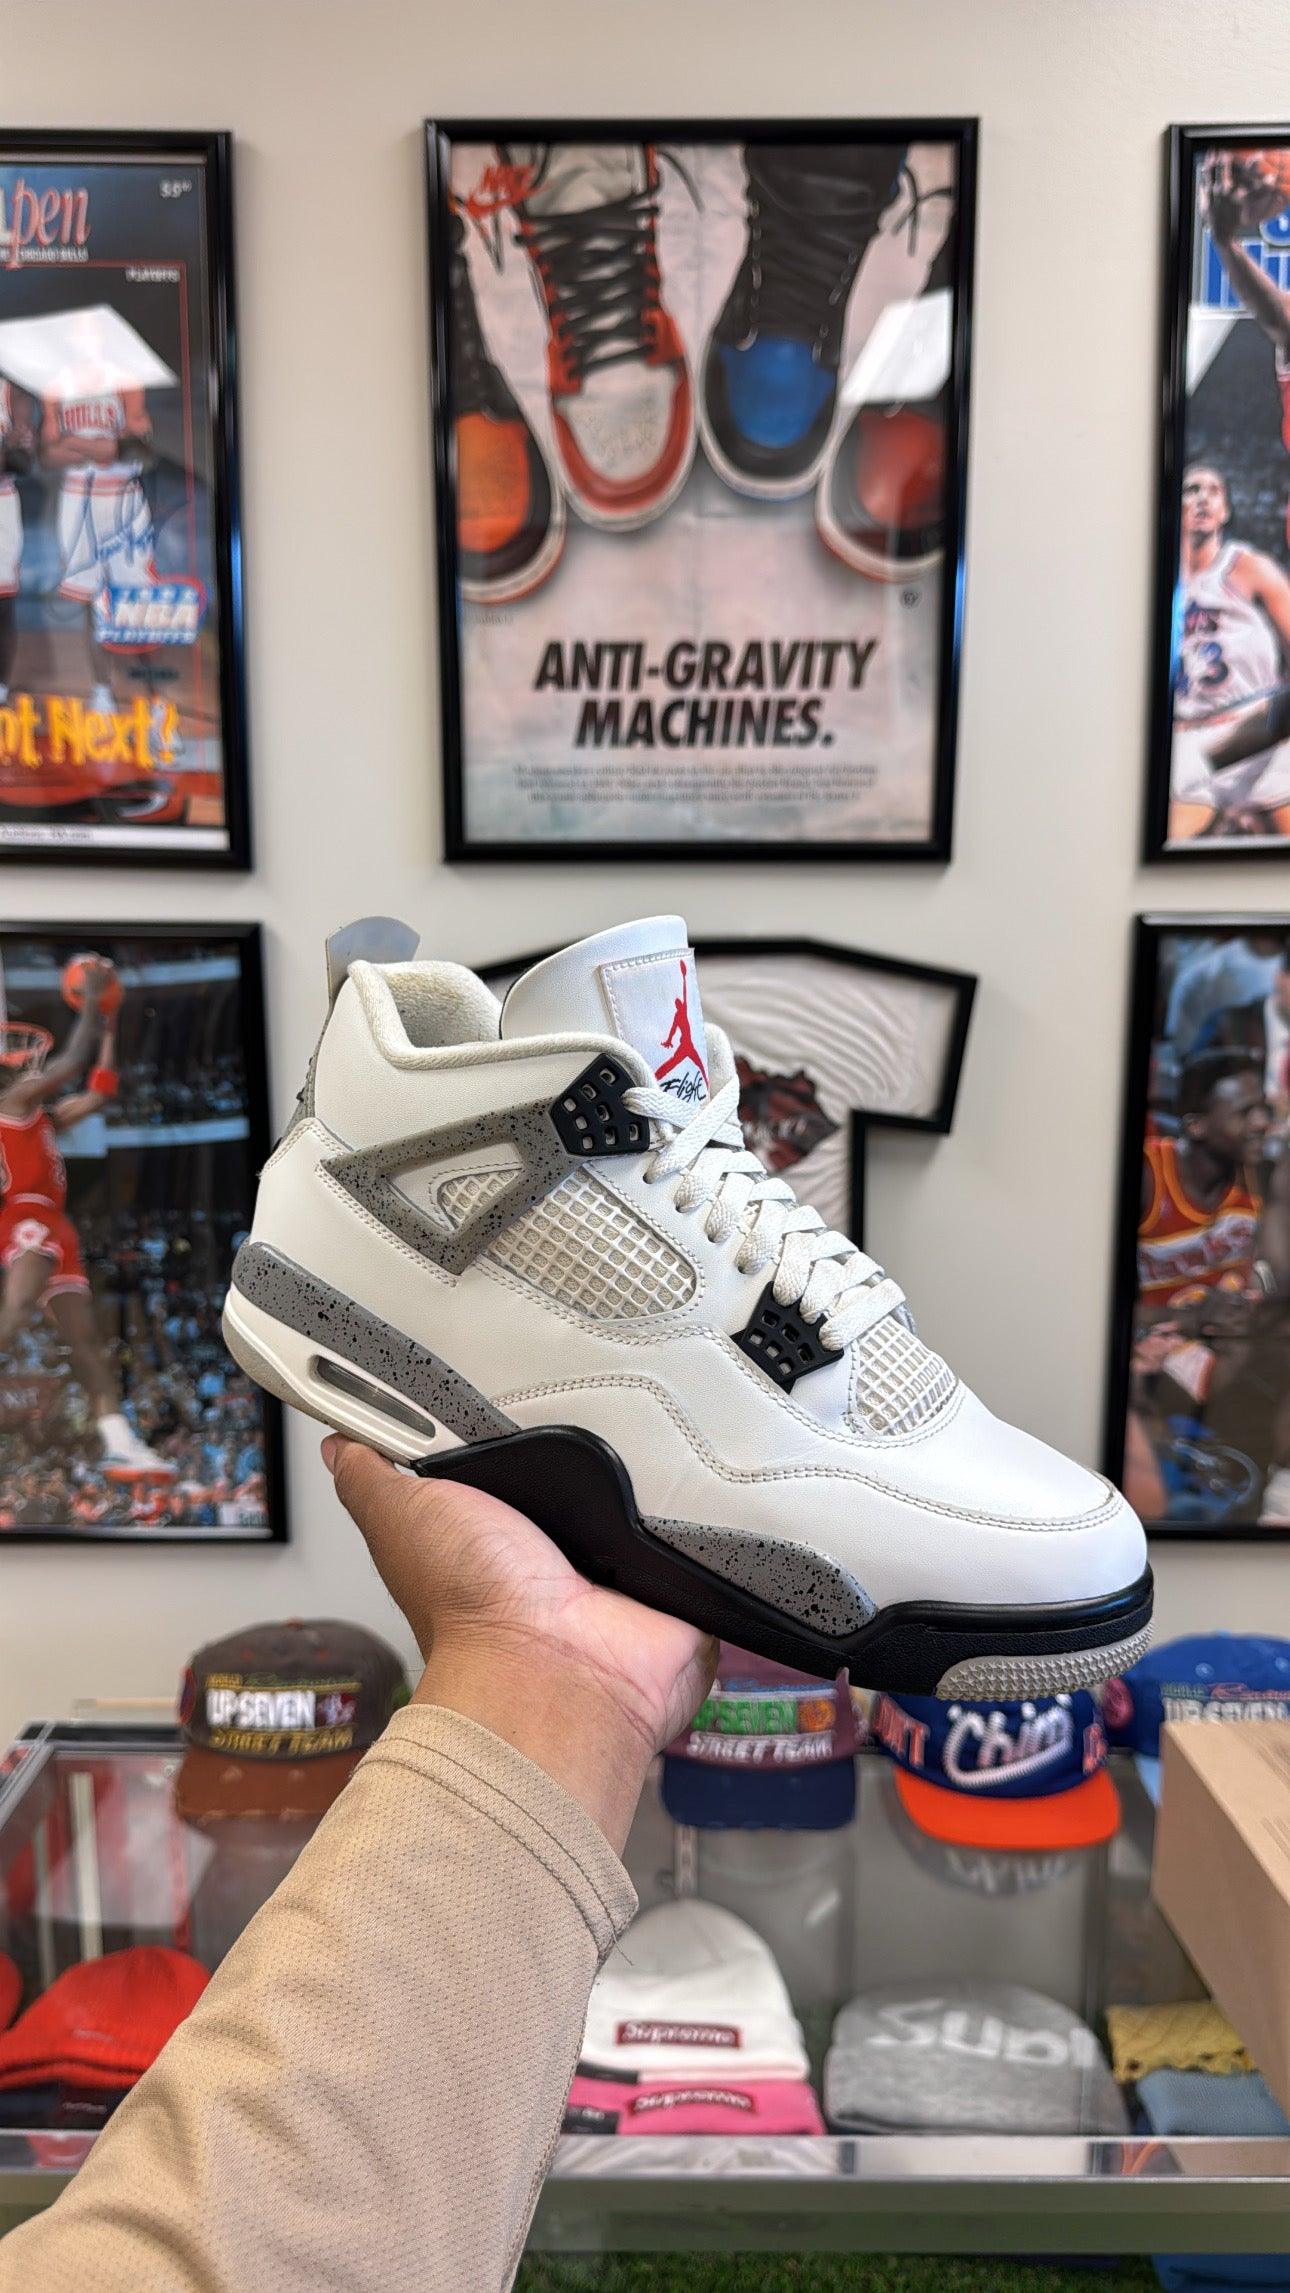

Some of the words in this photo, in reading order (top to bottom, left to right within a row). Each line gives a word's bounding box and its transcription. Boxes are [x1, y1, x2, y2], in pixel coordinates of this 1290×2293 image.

[534, 638, 878, 692] ANTI-GRAVITY
[574, 697, 836, 748] MACHINES.
[660, 1070, 707, 1103] Flight
[206, 1688, 316, 1730] UPSEVEN
[623, 2021, 735, 2044] Supreme
